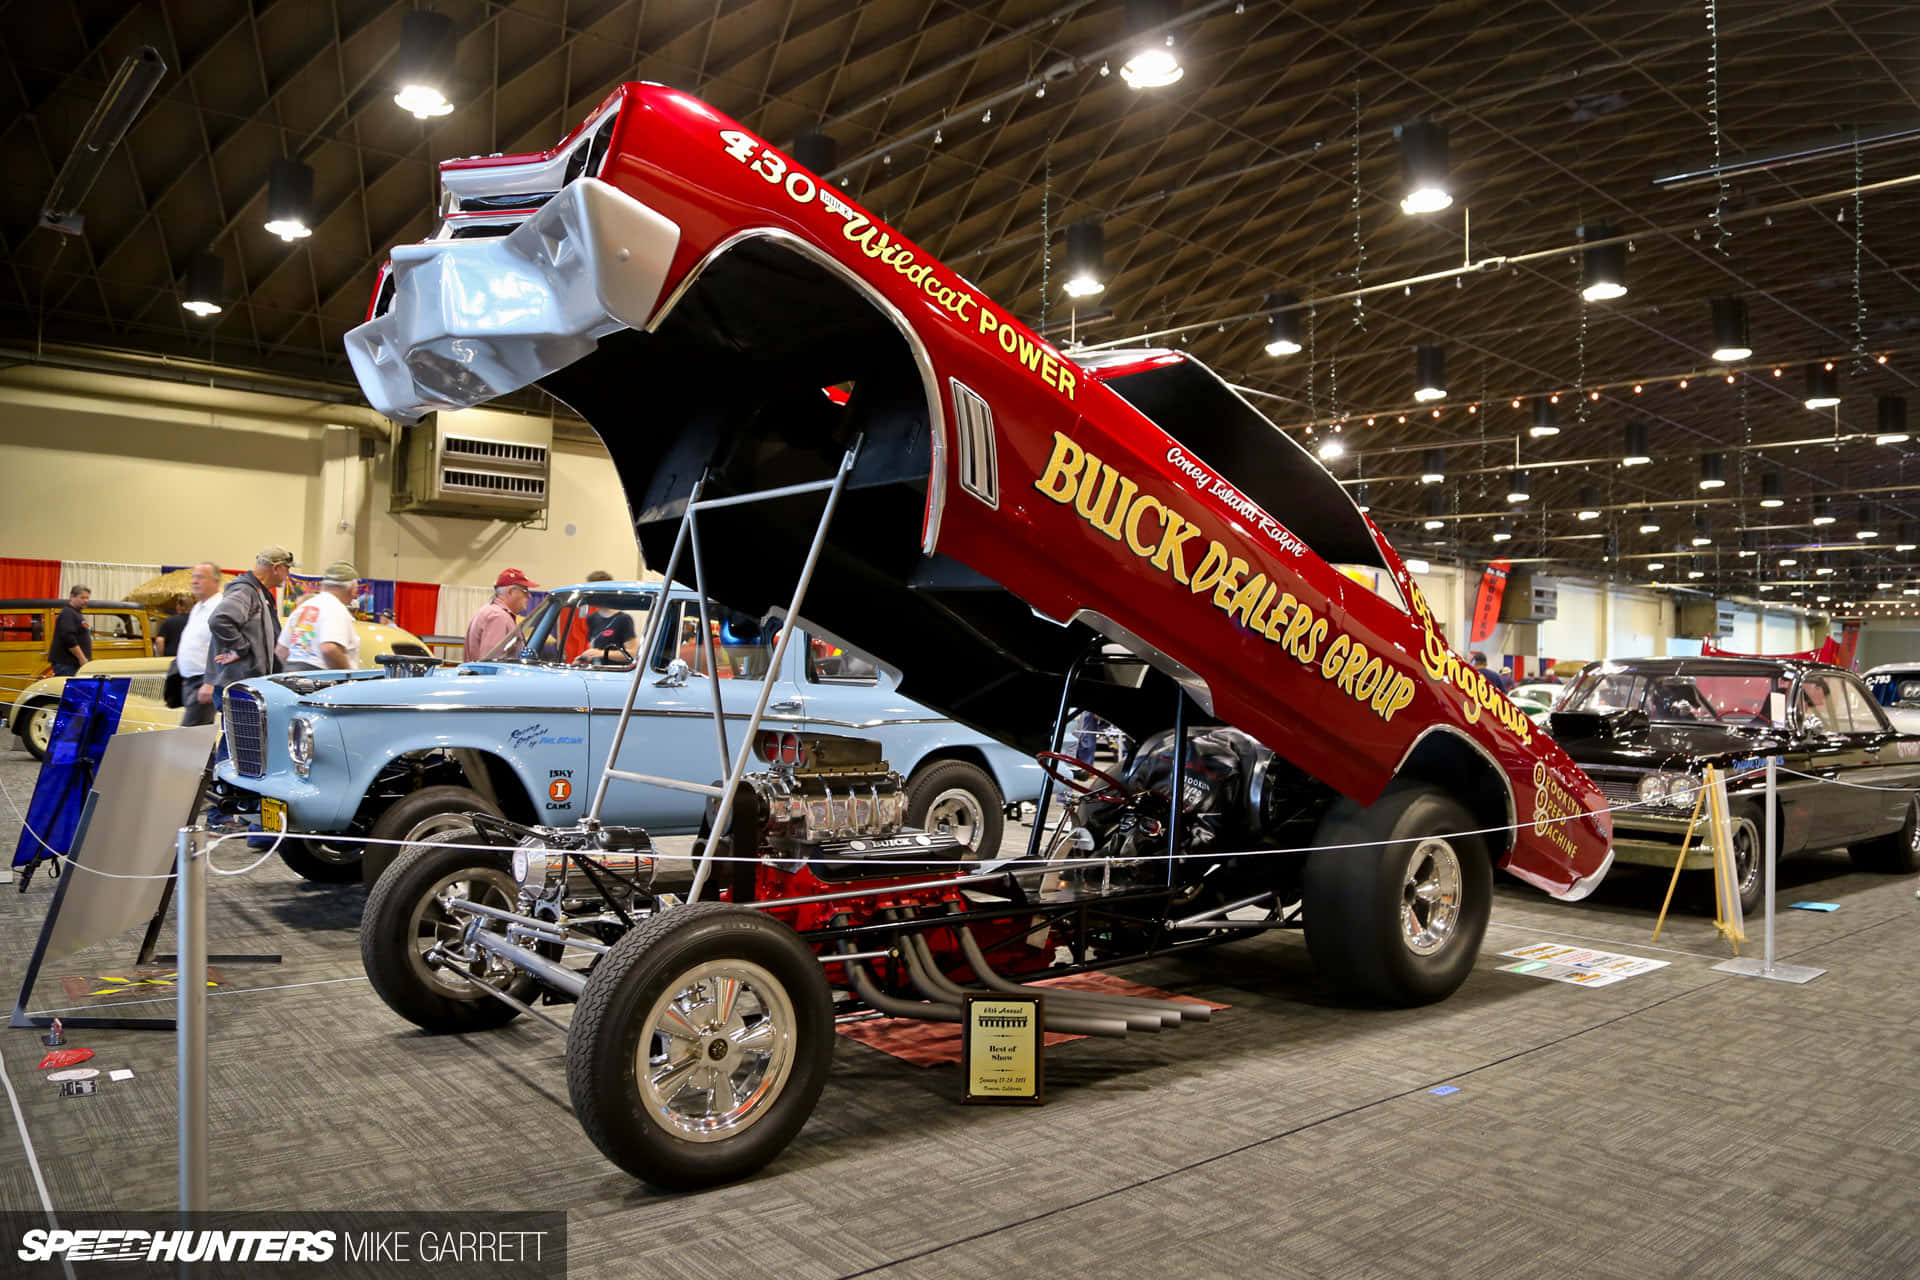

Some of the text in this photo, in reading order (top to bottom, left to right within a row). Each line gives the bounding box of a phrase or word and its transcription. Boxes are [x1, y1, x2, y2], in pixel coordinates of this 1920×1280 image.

[719, 130, 816, 203] 430
[826, 206, 1078, 400] Wildcat POWER
[1035, 431, 1201, 586] BUICK
[1191, 541, 1329, 664] DEALERS
[1321, 634, 1415, 721] GROUP
[549, 769, 574, 778] ISKY
[1535, 764, 1582, 816] BROOKLYN
[546, 802, 572, 810] CAMS
[1538, 790, 1567, 826] SPEED
[871, 838, 913, 848] BUICK
[1536, 813, 1578, 859] MACHINE
